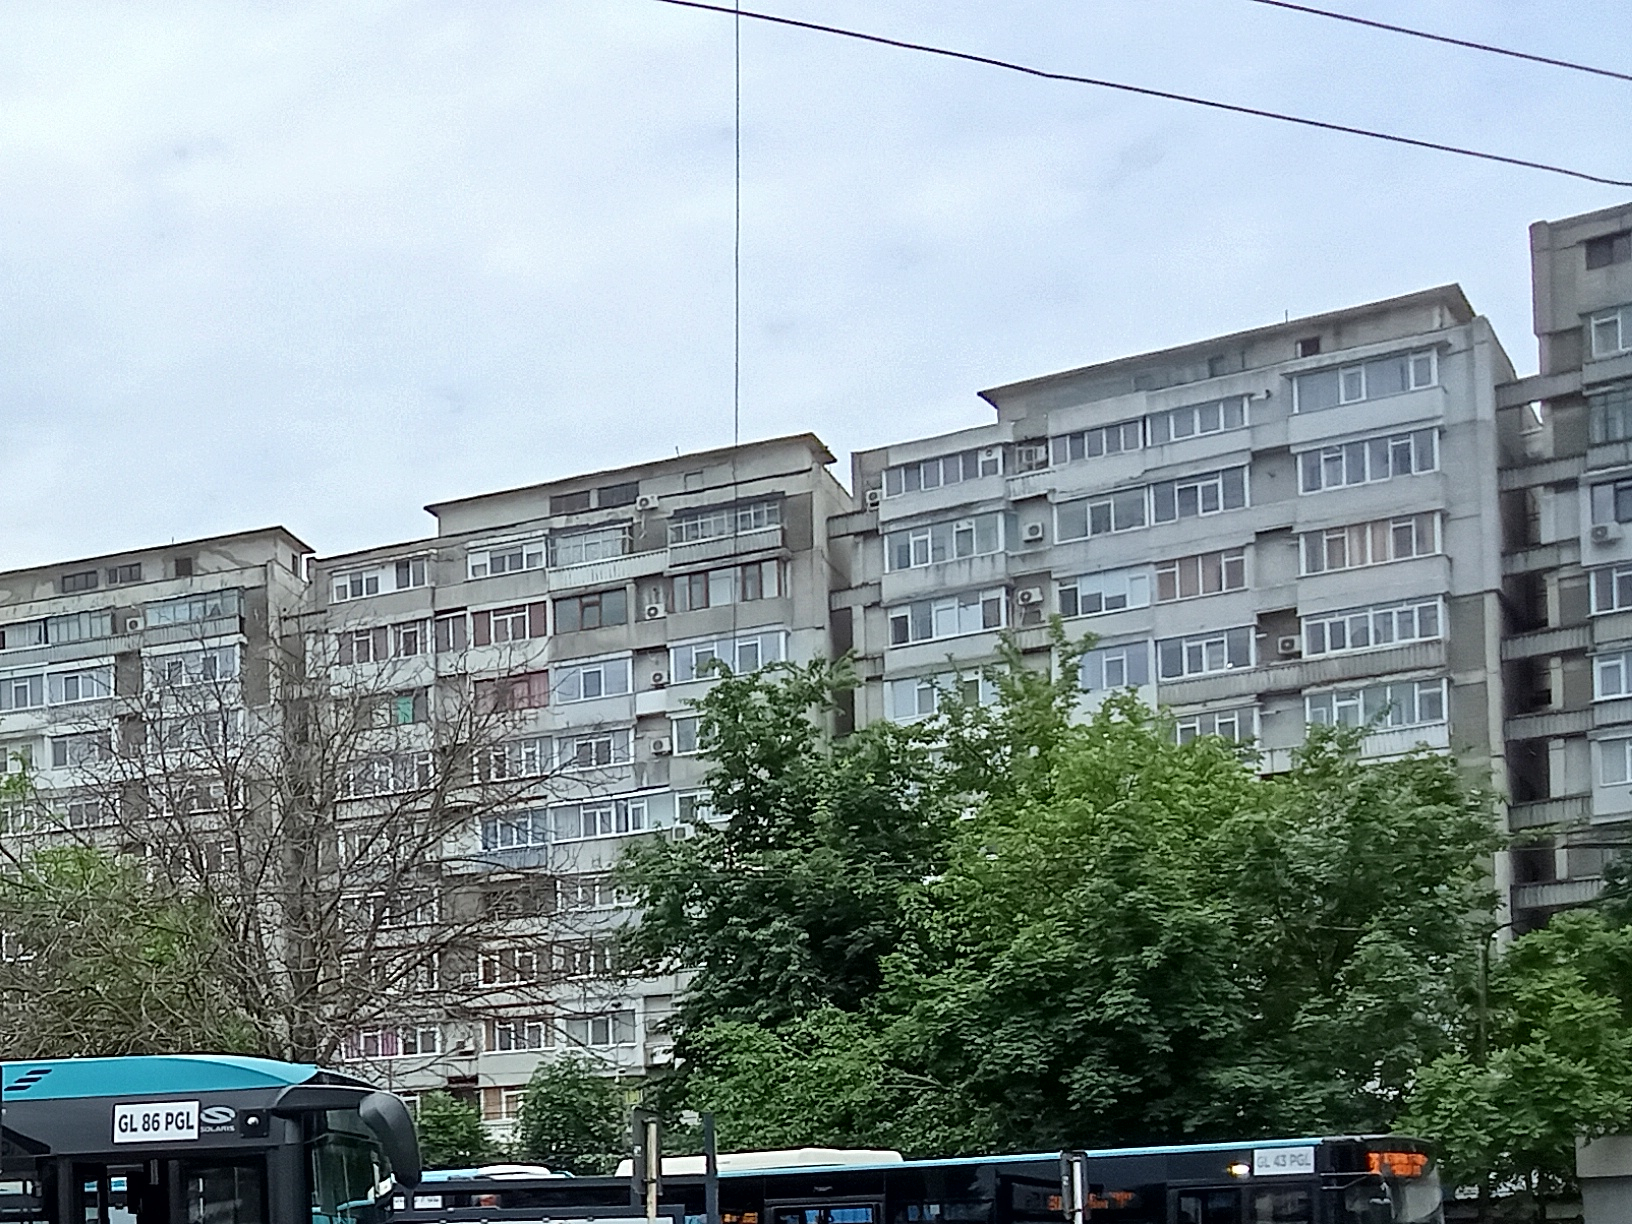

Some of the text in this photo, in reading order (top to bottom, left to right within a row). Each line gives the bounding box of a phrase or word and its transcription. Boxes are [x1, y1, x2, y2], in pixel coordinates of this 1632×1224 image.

[119, 1111, 194, 1133] GL 86 PGL
[200, 1125, 235, 1133] SOLARIS
[1257, 1153, 1311, 1168] GL 43 PGL
